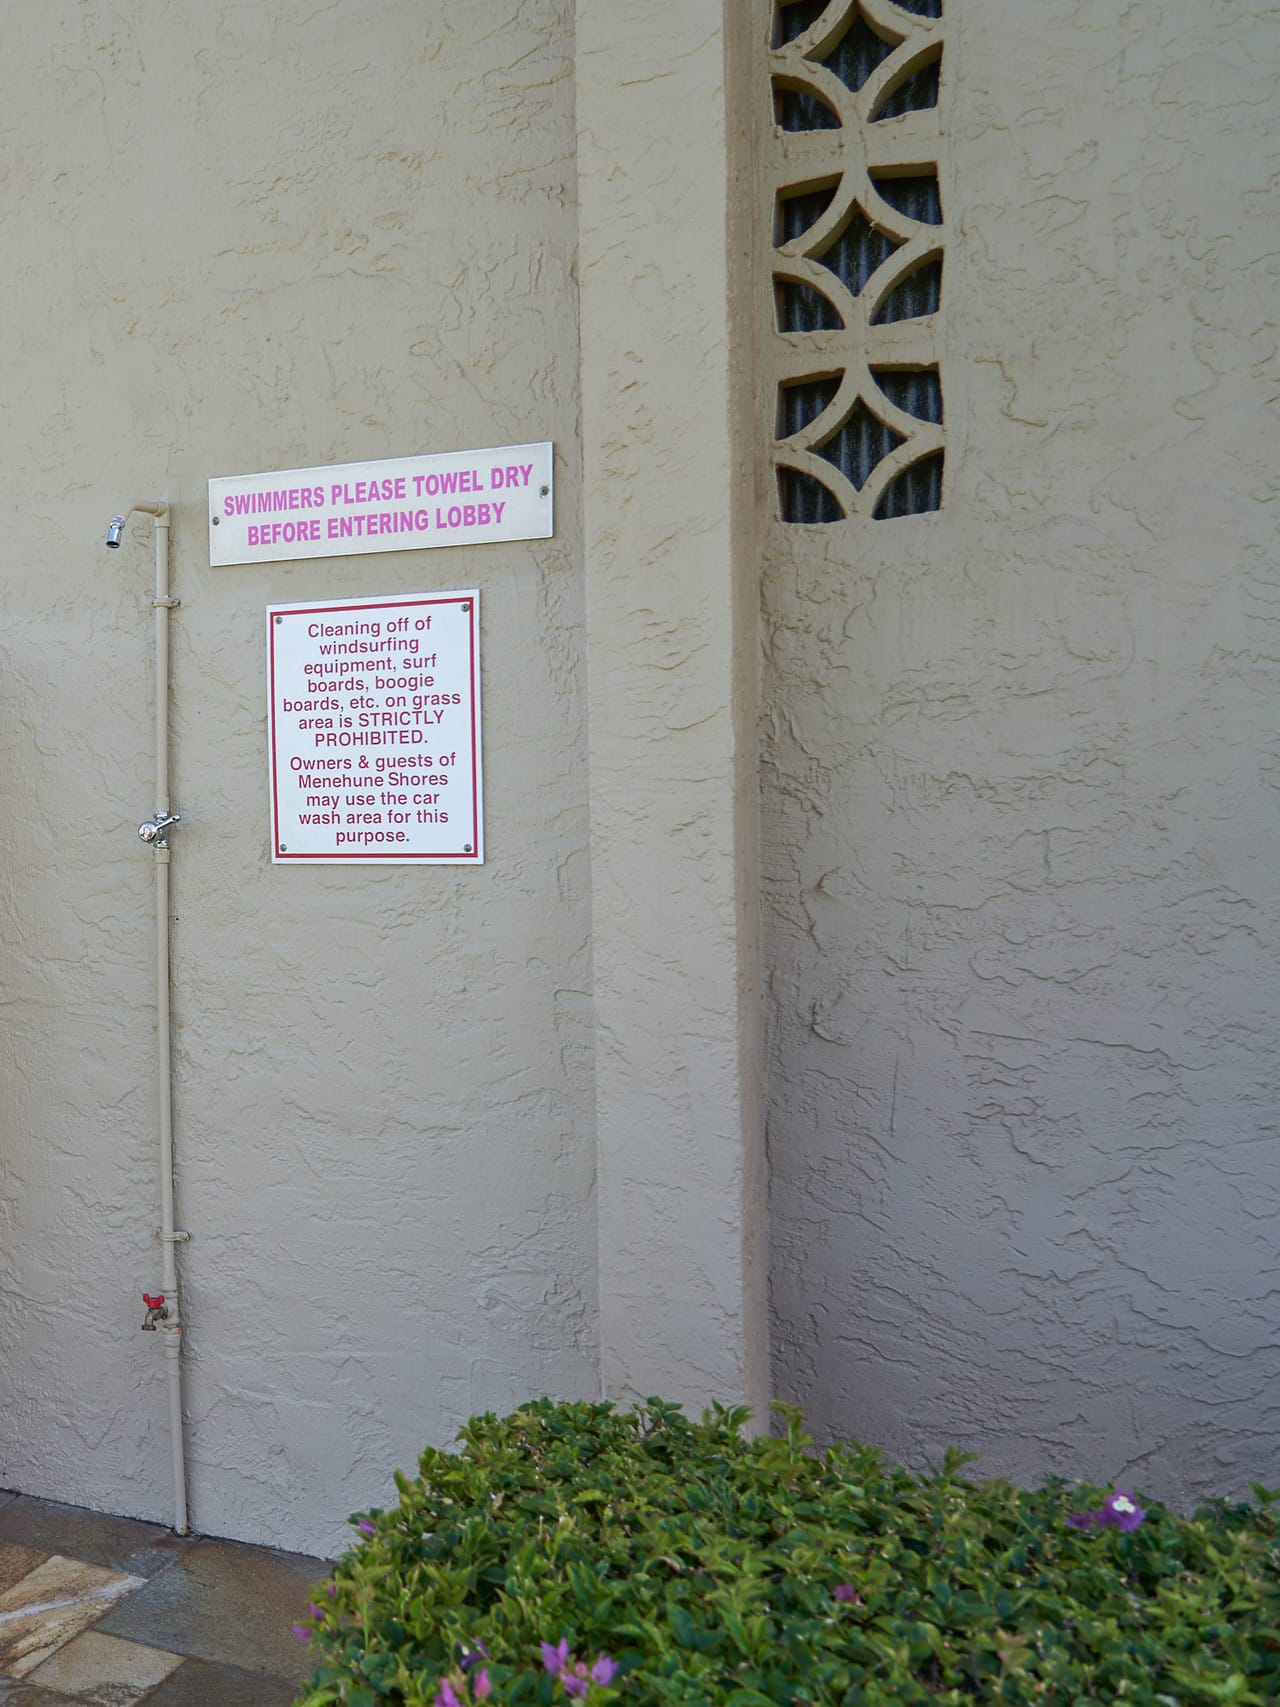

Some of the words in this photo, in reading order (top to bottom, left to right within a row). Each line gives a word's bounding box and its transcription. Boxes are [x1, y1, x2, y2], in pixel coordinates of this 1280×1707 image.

[224, 486, 325, 516] SWIMMERS
[331, 477, 406, 505] PLEASE
[412, 470, 484, 497] TOWEL
[491, 464, 533, 489] DRY
[248, 520, 320, 546] BEFORE
[327, 509, 428, 538] ENTERING
[436, 502, 506, 529] LOBBY
[308, 621, 380, 638] Cleaning
[386, 617, 409, 632] off
[415, 616, 432, 630] of
[320, 638, 419, 655] windsurfing
[304, 657, 396, 677] equipment,
[403, 653, 437, 669] surf
[308, 677, 369, 693] boards,
[375, 674, 434, 691] boogie
[283, 697, 344, 712] boards,
[350, 696, 379, 709] etc.
[385, 695, 406, 707] on
[413, 693, 461, 709] grass
[299, 717, 333, 729] area
[339, 714, 352, 728] is
[359, 710, 444, 727] STRICTLY
[315, 730, 428, 747] PROHIBITED.
[290, 756, 352, 771] Owners
[358, 755, 369, 768] &
[376, 754, 433, 772] guests
[439, 752, 456, 767] of
[298, 774, 384, 788] Menehune
[388, 772, 448, 787] Shores
[307, 794, 339, 809] may
[346, 794, 375, 806] use
[381, 792, 407, 805] the
[413, 793, 439, 805] car
[299, 811, 340, 824] wash
[346, 812, 382, 824] area
[387, 810, 411, 823] for
[417, 809, 448, 823] this
[336, 831, 410, 845] purpose.
